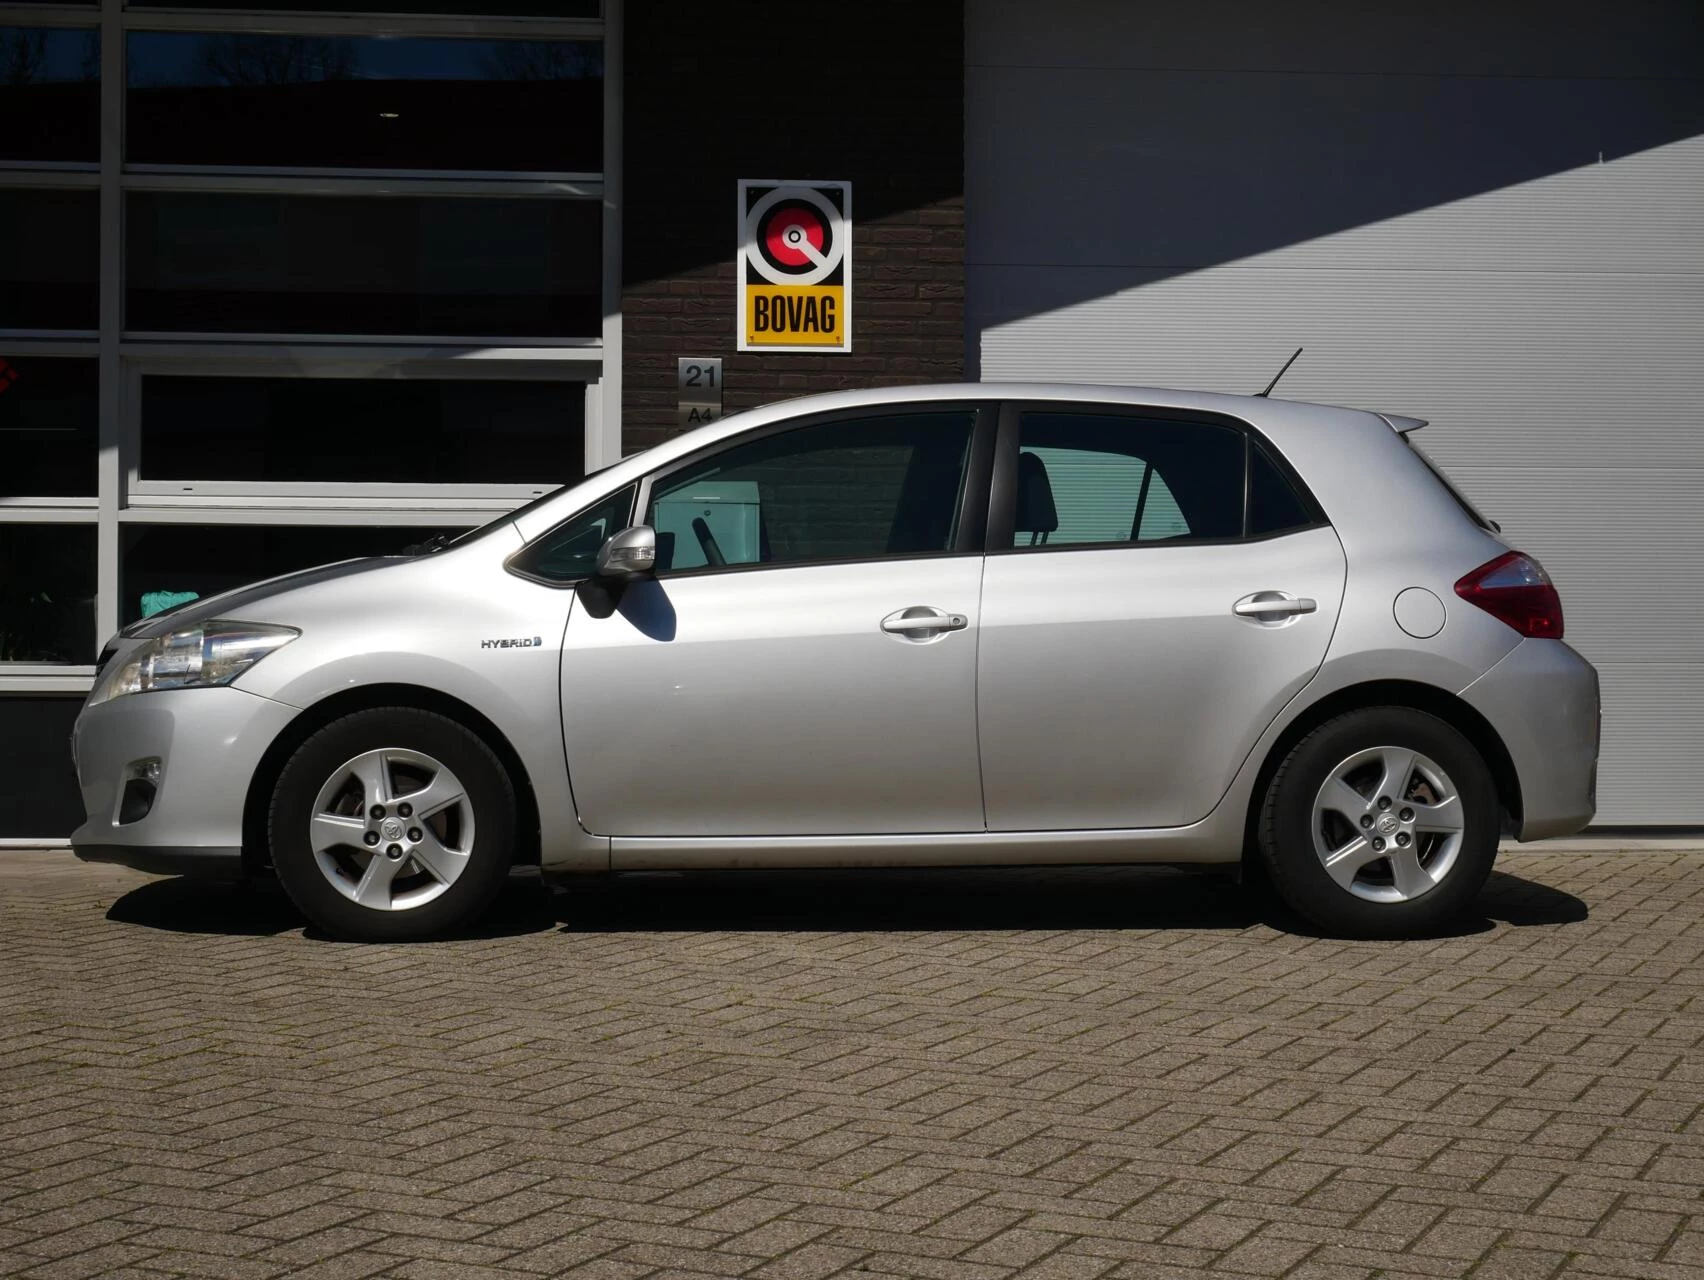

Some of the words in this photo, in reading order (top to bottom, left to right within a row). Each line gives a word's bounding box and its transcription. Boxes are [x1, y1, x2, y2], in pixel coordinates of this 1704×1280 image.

[754, 295, 835, 333] BOVAG
[686, 365, 715, 387] 21
[687, 407, 713, 423] A4
[481, 638, 533, 649] HYBRID
